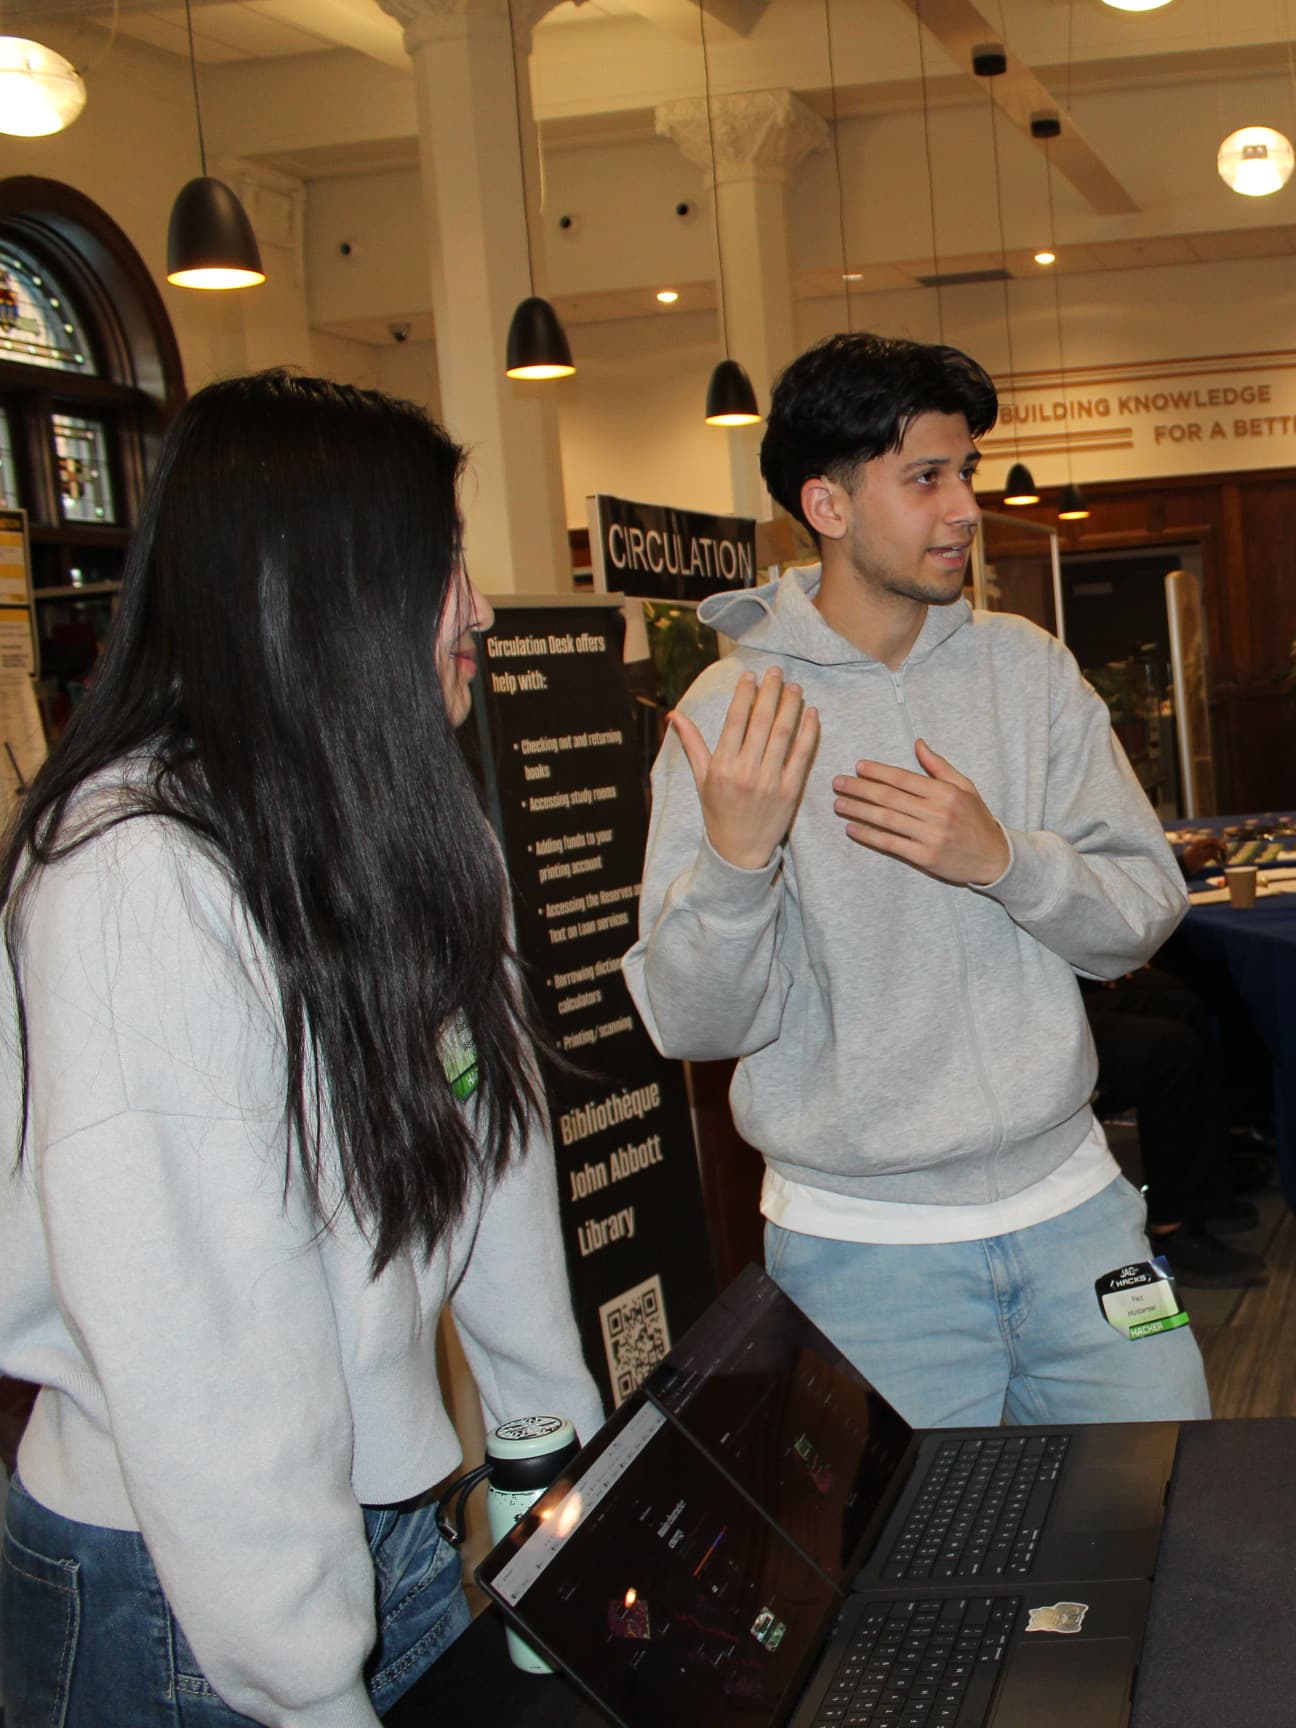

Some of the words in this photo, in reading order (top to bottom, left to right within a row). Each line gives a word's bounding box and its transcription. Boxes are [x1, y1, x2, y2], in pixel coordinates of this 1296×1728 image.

[1000, 397, 1110, 425] BUILDING
[1119, 385, 1271, 415] KNOWLEDGE
[1155, 424, 1202, 445] FOR
[1210, 422, 1227, 440] A
[608, 523, 753, 580] CIRCULATION
[487, 634, 547, 658] Circulation
[548, 634, 575, 655] Desk
[575, 633, 605, 653] offers
[491, 671, 517, 695] help
[517, 669, 548, 691] with:
[521, 736, 558, 755] Checking
[559, 735, 573, 750] out
[573, 732, 588, 748] and
[588, 728, 623, 746] returning
[524, 763, 550, 781] books
[530, 791, 569, 812] Accessing
[569, 788, 592, 806] study
[593, 785, 617, 802] rooms
[536, 837, 563, 856] Adding
[563, 833, 586, 850] funds
[586, 832, 595, 846] to
[595, 829, 613, 846] your
[539, 863, 571, 884] printing
[572, 855, 602, 874] account
[546, 896, 585, 918] Accessing
[586, 892, 599, 909] the
[600, 884, 633, 905] Reserves
[549, 927, 567, 944] Text
[568, 924, 578, 939] on
[578, 920, 596, 936] Loan
[597, 912, 629, 931] services
[554, 965, 595, 989] Borrowing
[558, 989, 602, 1015] calculators
[560, 1082, 661, 1146] Bibliothèque
[570, 1161, 607, 1201] John
[610, 1134, 663, 1184] Abbott
[578, 1206, 636, 1257] Library
